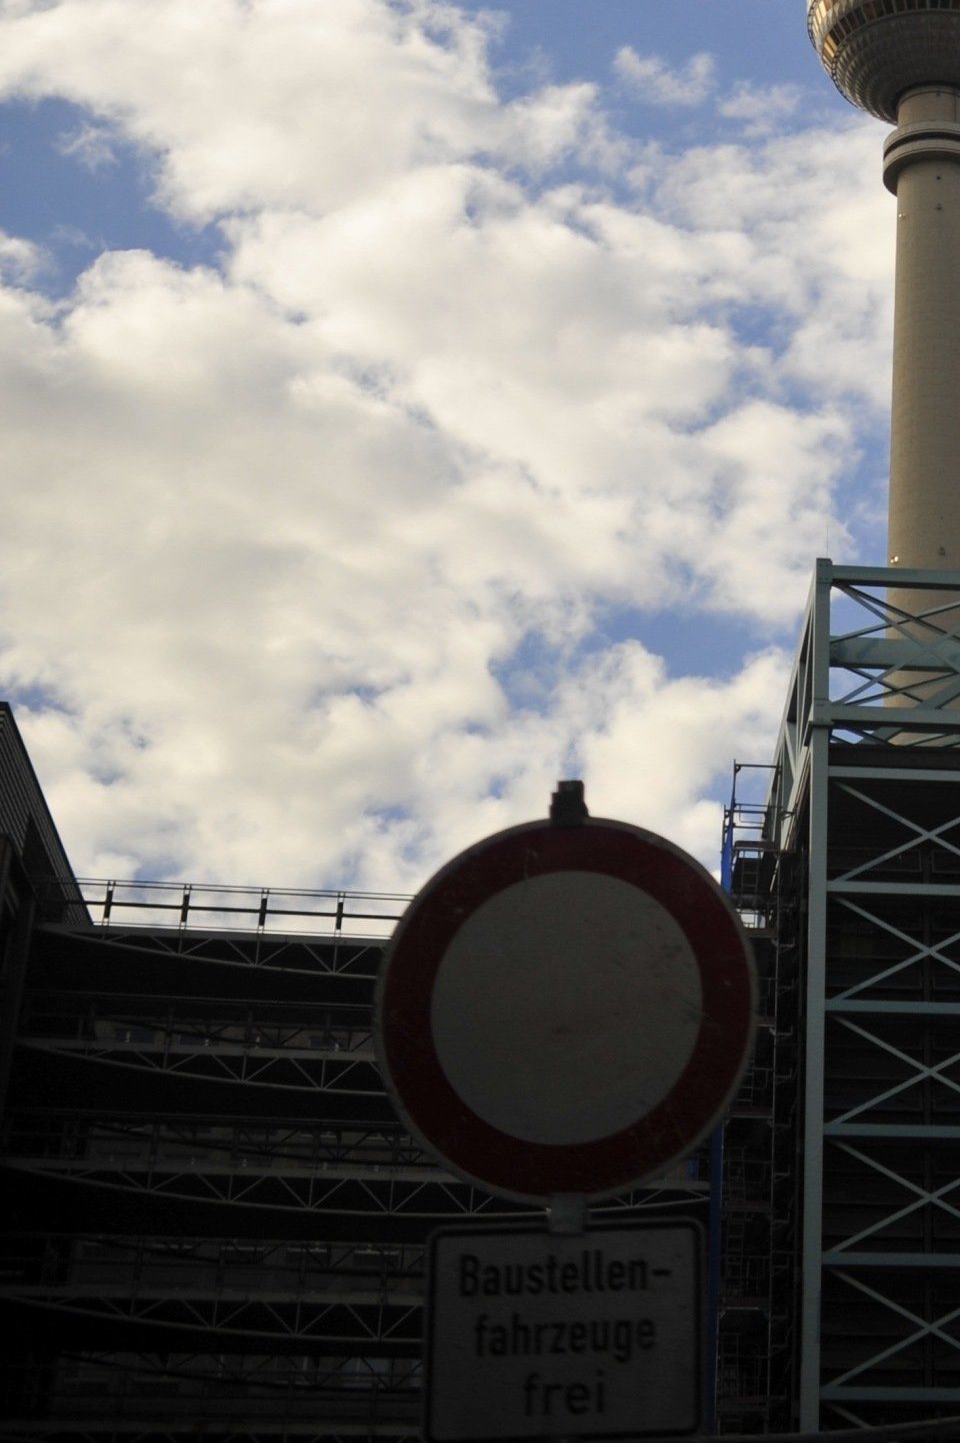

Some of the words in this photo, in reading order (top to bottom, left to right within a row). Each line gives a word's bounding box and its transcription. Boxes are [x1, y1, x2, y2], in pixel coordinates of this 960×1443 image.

[460, 1250, 671, 1297] Baustellen-
[474, 1313, 656, 1362] fahrzeuge
[523, 1370, 605, 1416] frei
